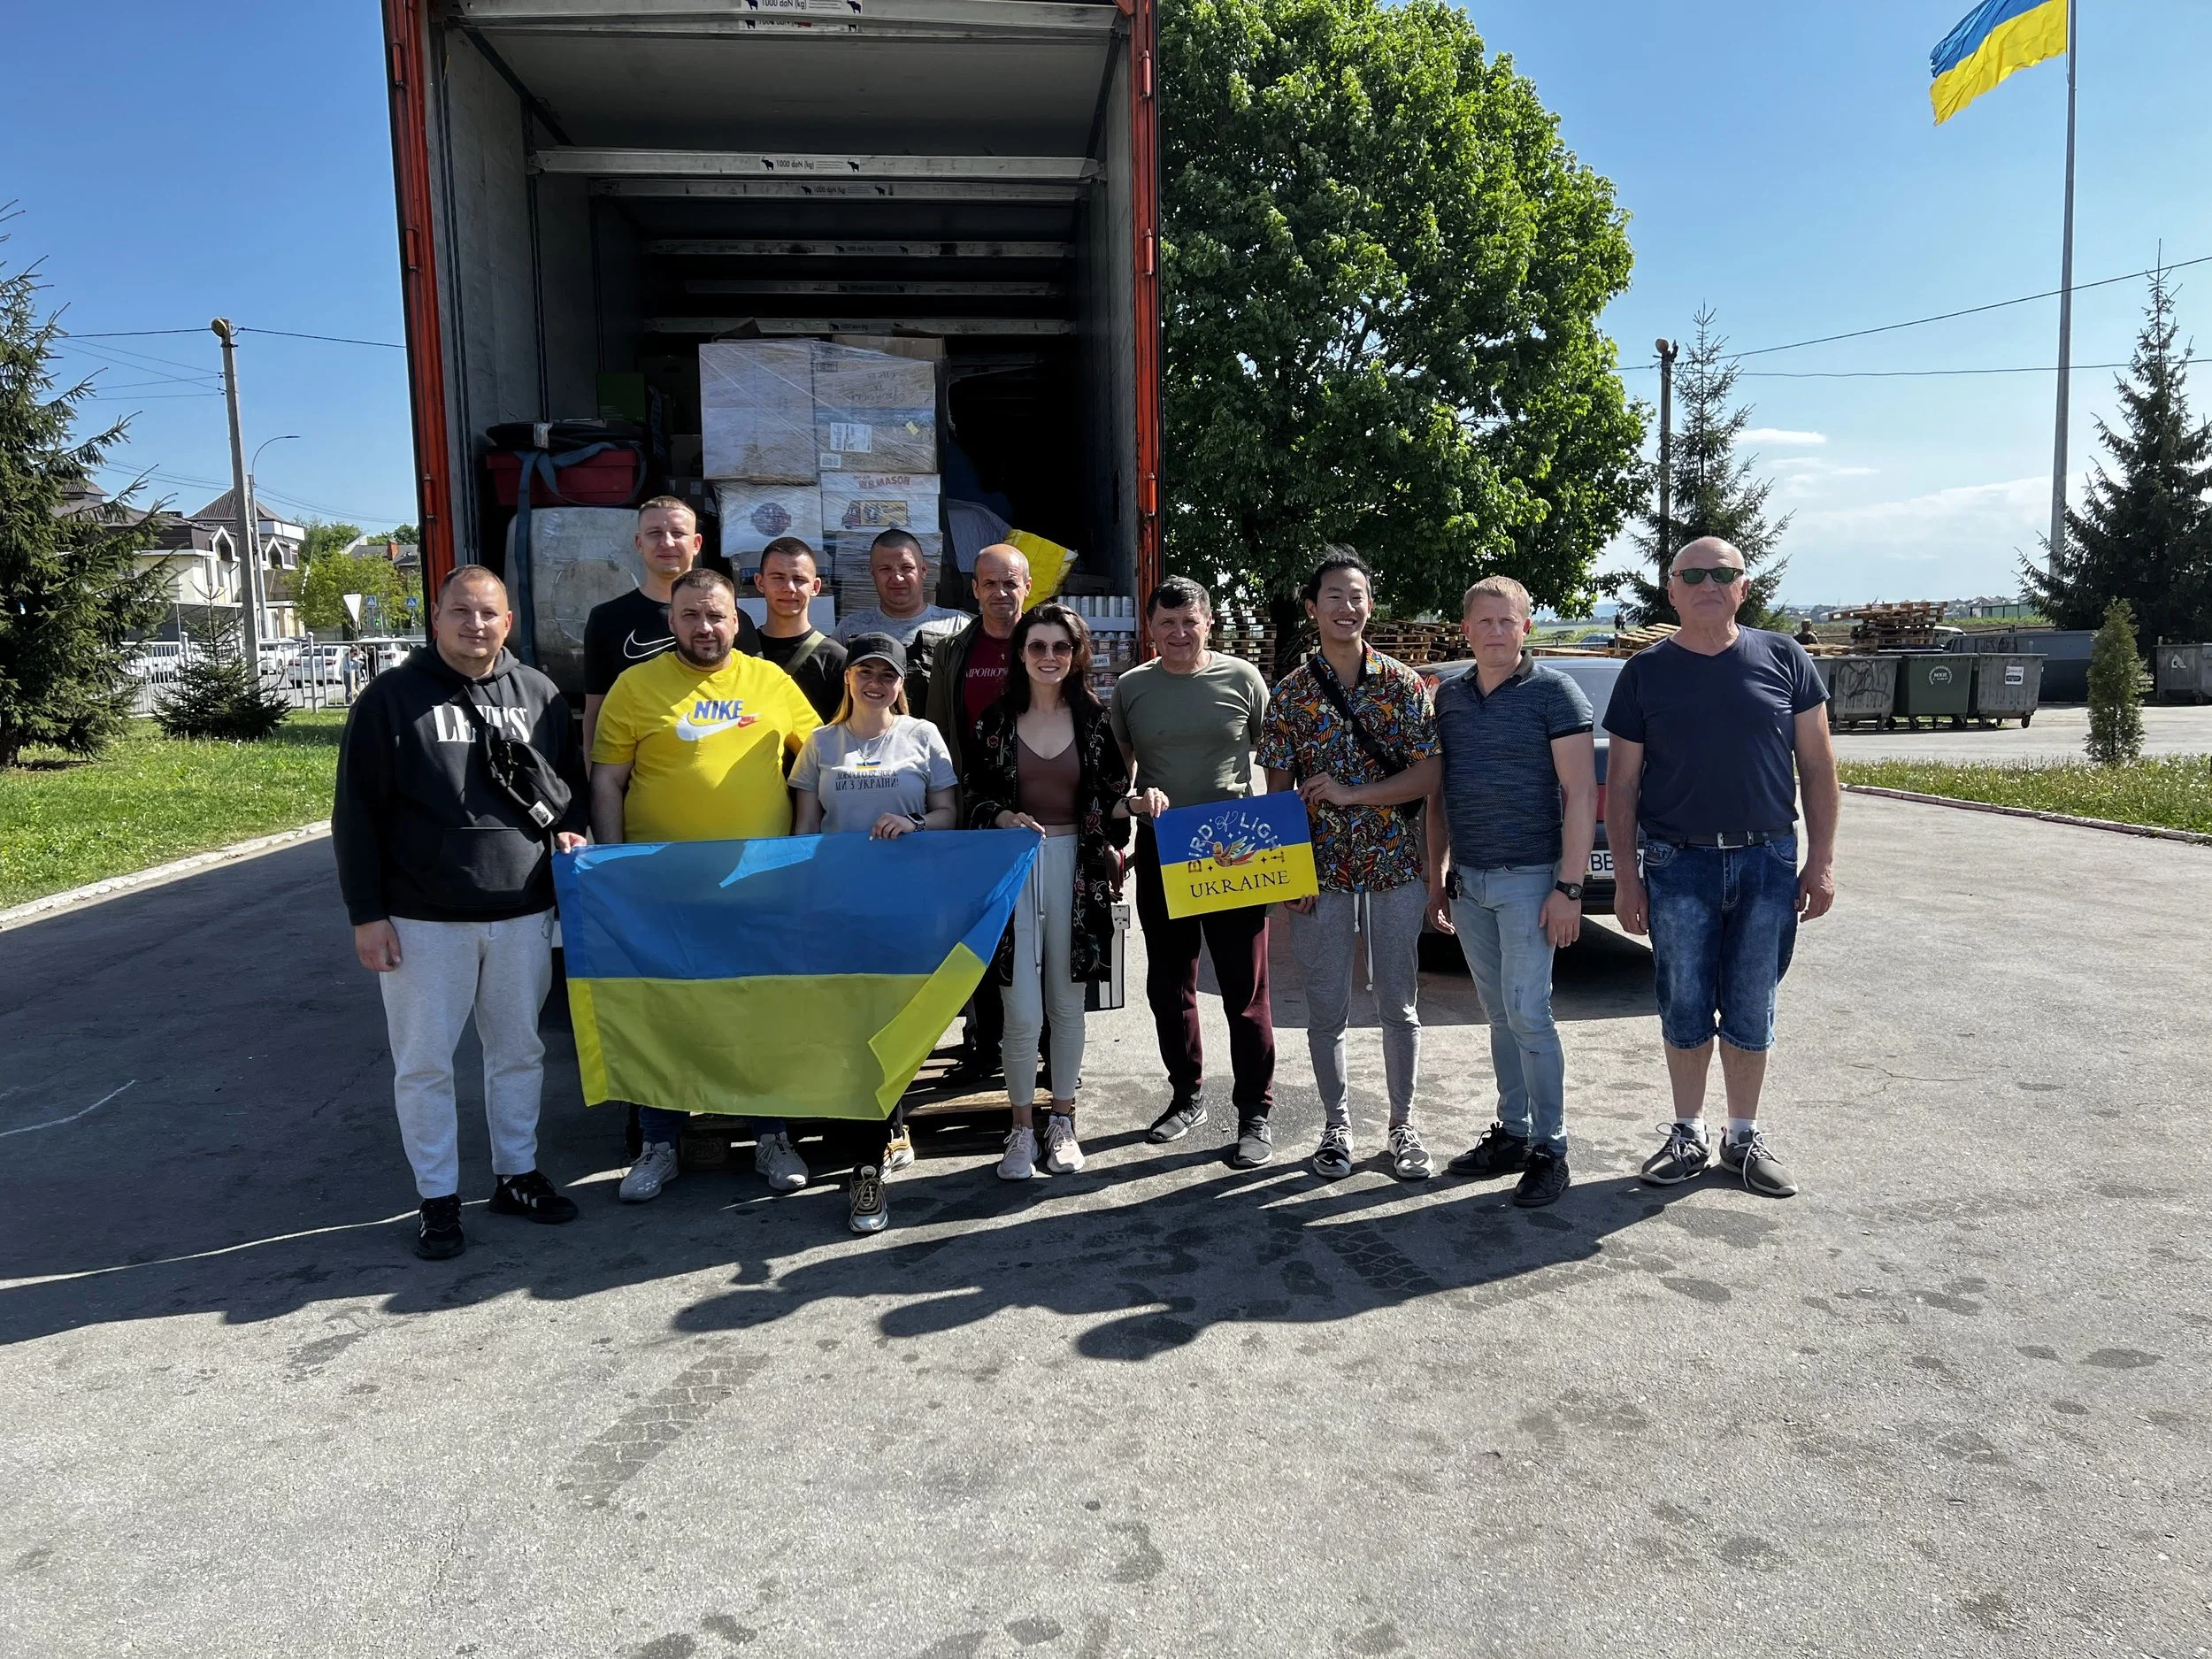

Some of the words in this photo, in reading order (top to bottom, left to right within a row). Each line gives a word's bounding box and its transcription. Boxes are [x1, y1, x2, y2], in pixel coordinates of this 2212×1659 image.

[776, 159, 790, 168] 1000
[791, 159, 803, 168] daN
[694, 700, 744, 720] NIKE
[1214, 810, 1239, 833] of
[1189, 870, 1291, 898] UKRAINE
